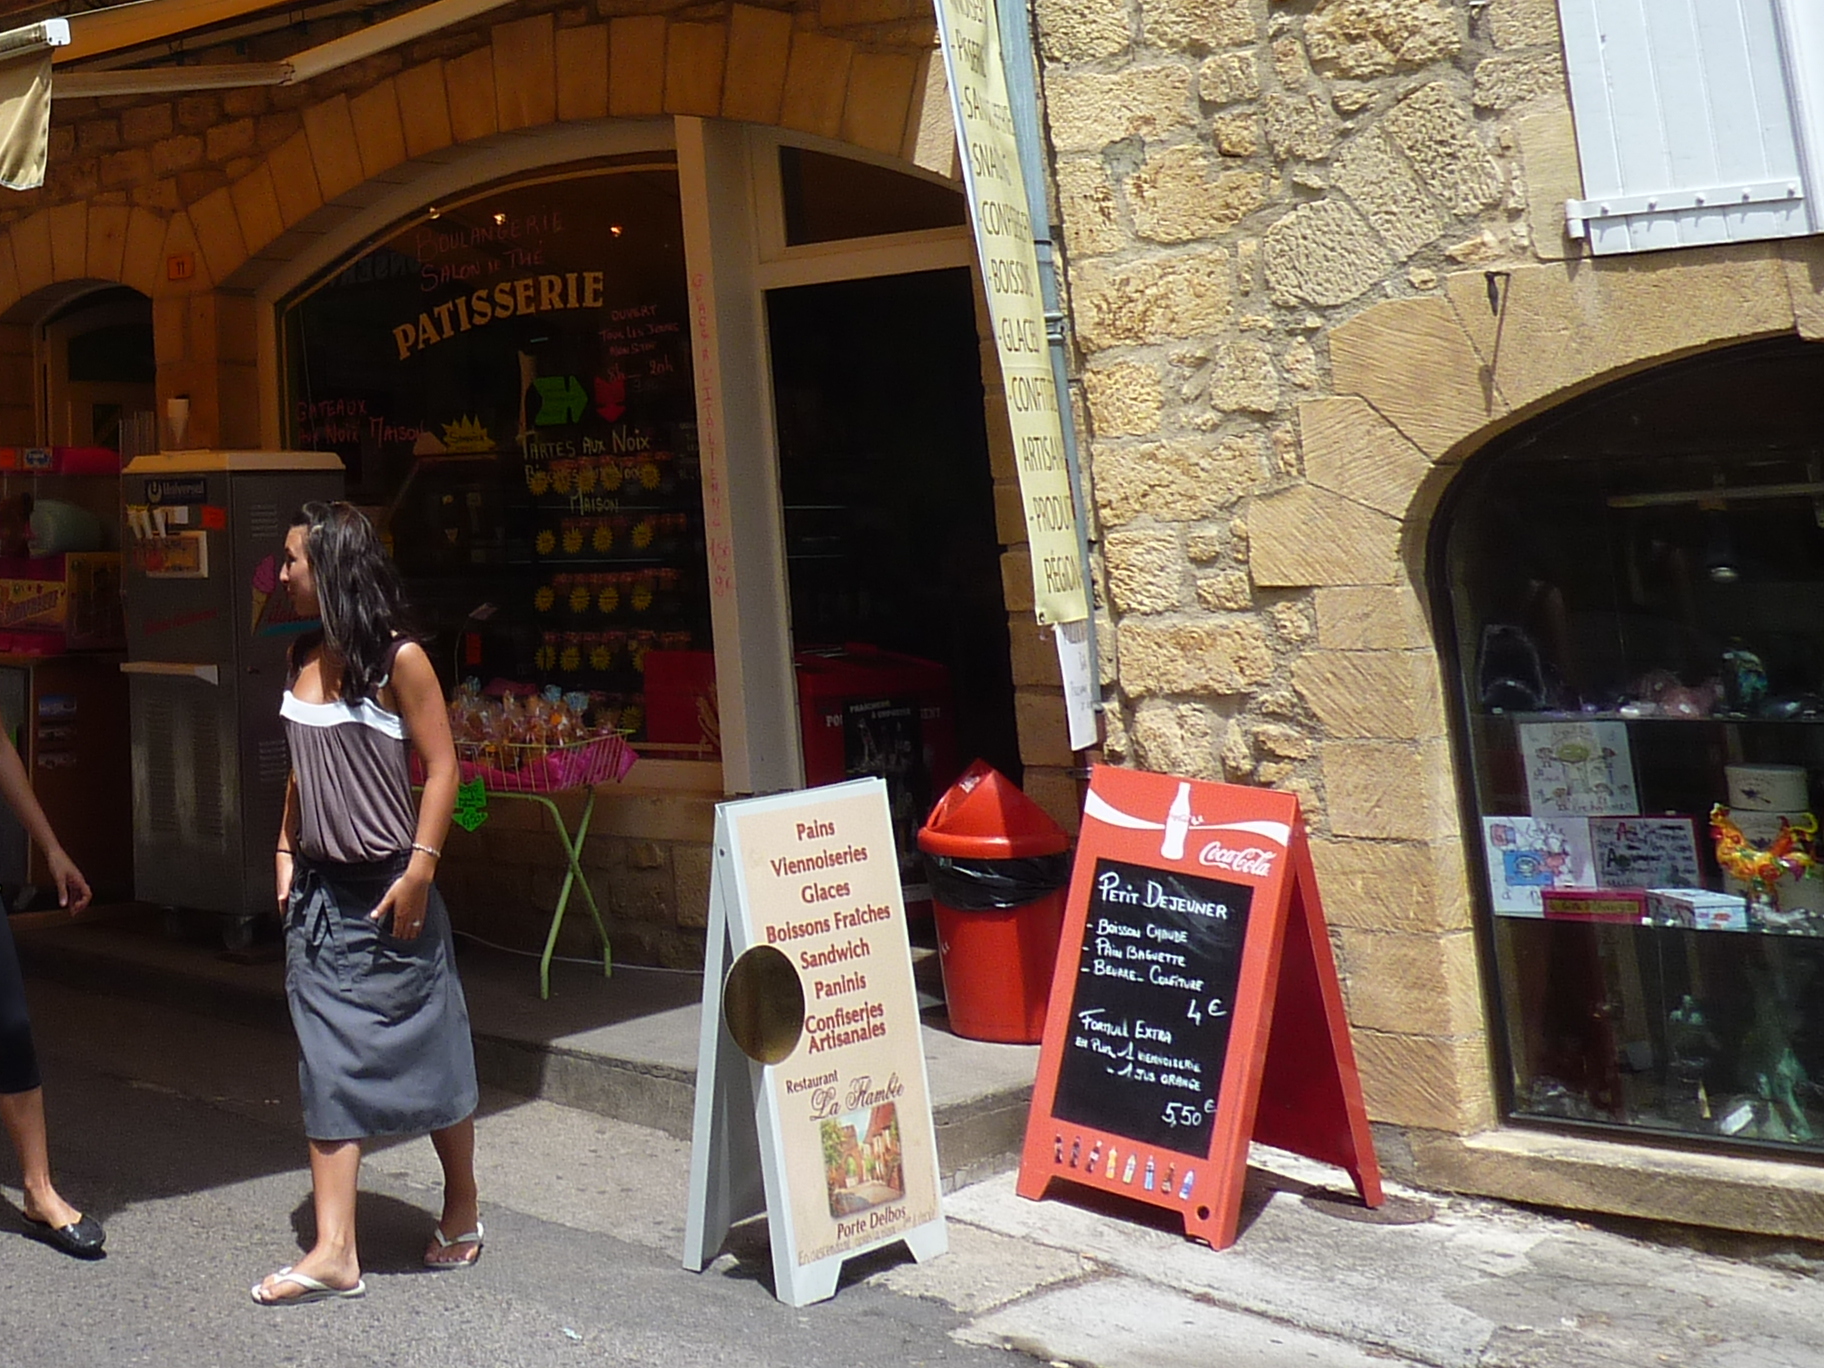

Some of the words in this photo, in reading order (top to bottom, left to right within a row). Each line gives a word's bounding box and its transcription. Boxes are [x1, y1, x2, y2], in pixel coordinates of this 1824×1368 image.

[392, 270, 604, 362] PATISSERIE
[795, 819, 836, 841] Pains
[769, 844, 868, 878] Viennoiseries
[800, 881, 852, 904] Glaces
[1142, 878, 1228, 921] DEJEUNER
[765, 918, 832, 945] Boissons
[832, 903, 892, 931] Fraîches
[799, 936, 871, 970] Sandwich
[814, 970, 868, 1000] Paninis
[804, 1000, 885, 1035] Confiseries
[1186, 998, 1202, 1027] 4
[808, 1020, 887, 1055] Artisanales
[1134, 1019, 1173, 1045] EXTRA
[785, 1068, 839, 1096] Restaurant
[1161, 1101, 1203, 1129] 5,50
[837, 1218, 867, 1241] Porte
[870, 1205, 907, 1230] Delbos
